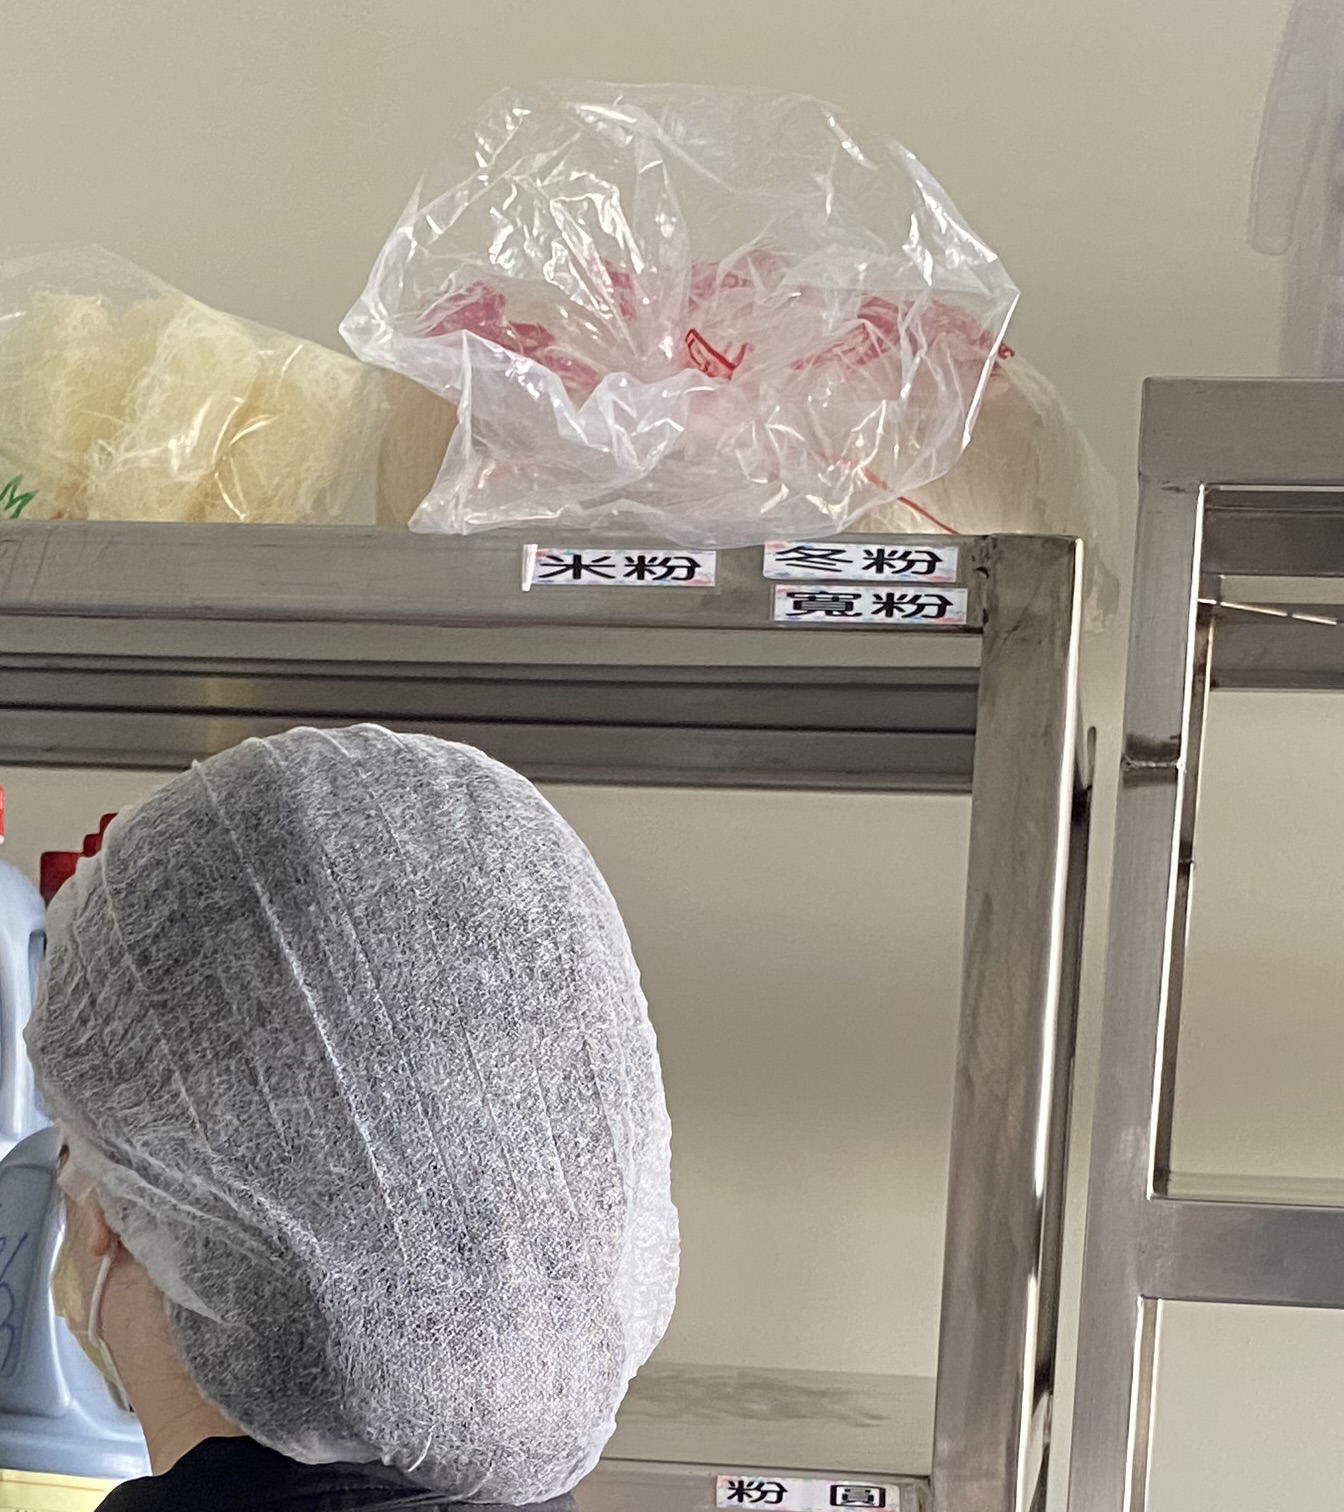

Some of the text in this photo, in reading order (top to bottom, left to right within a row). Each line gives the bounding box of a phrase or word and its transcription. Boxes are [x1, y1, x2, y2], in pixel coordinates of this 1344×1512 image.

[538, 553, 702, 582] 米粉
[774, 545, 944, 575] 冬粉
[785, 590, 954, 619] 寬粉
[727, 1479, 887, 1509] 粉圓
